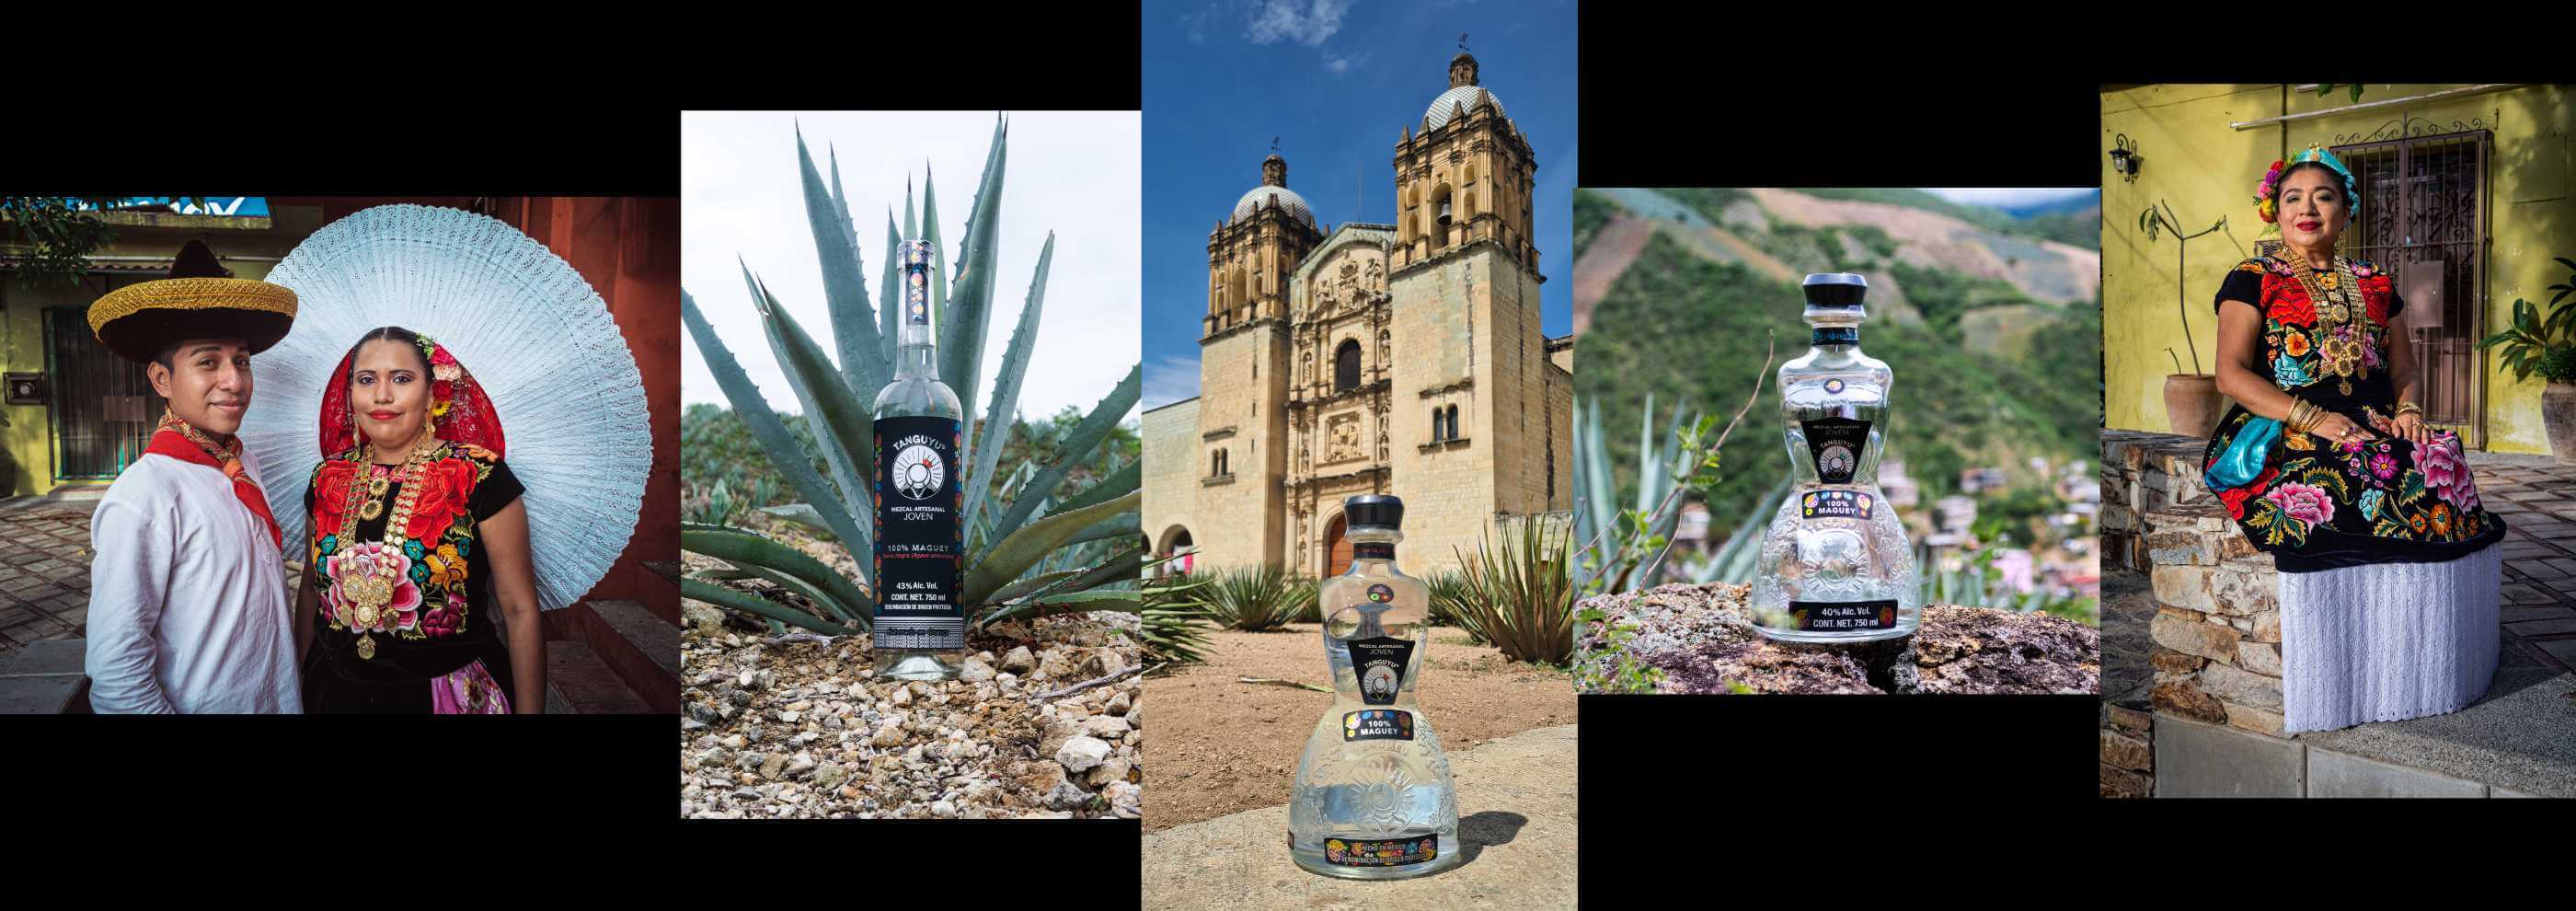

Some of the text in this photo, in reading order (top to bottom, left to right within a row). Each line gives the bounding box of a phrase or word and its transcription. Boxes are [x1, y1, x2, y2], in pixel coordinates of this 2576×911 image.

[903, 513, 934, 521] JOVEN
[896, 582, 938, 590] 43% Alc. Vol.
[1822, 606, 1871, 617] 40% Alc. Vol.
[1812, 617, 1879, 628] CONT. NET. 750 ml
[1360, 728, 1398, 736] MAGUEY
